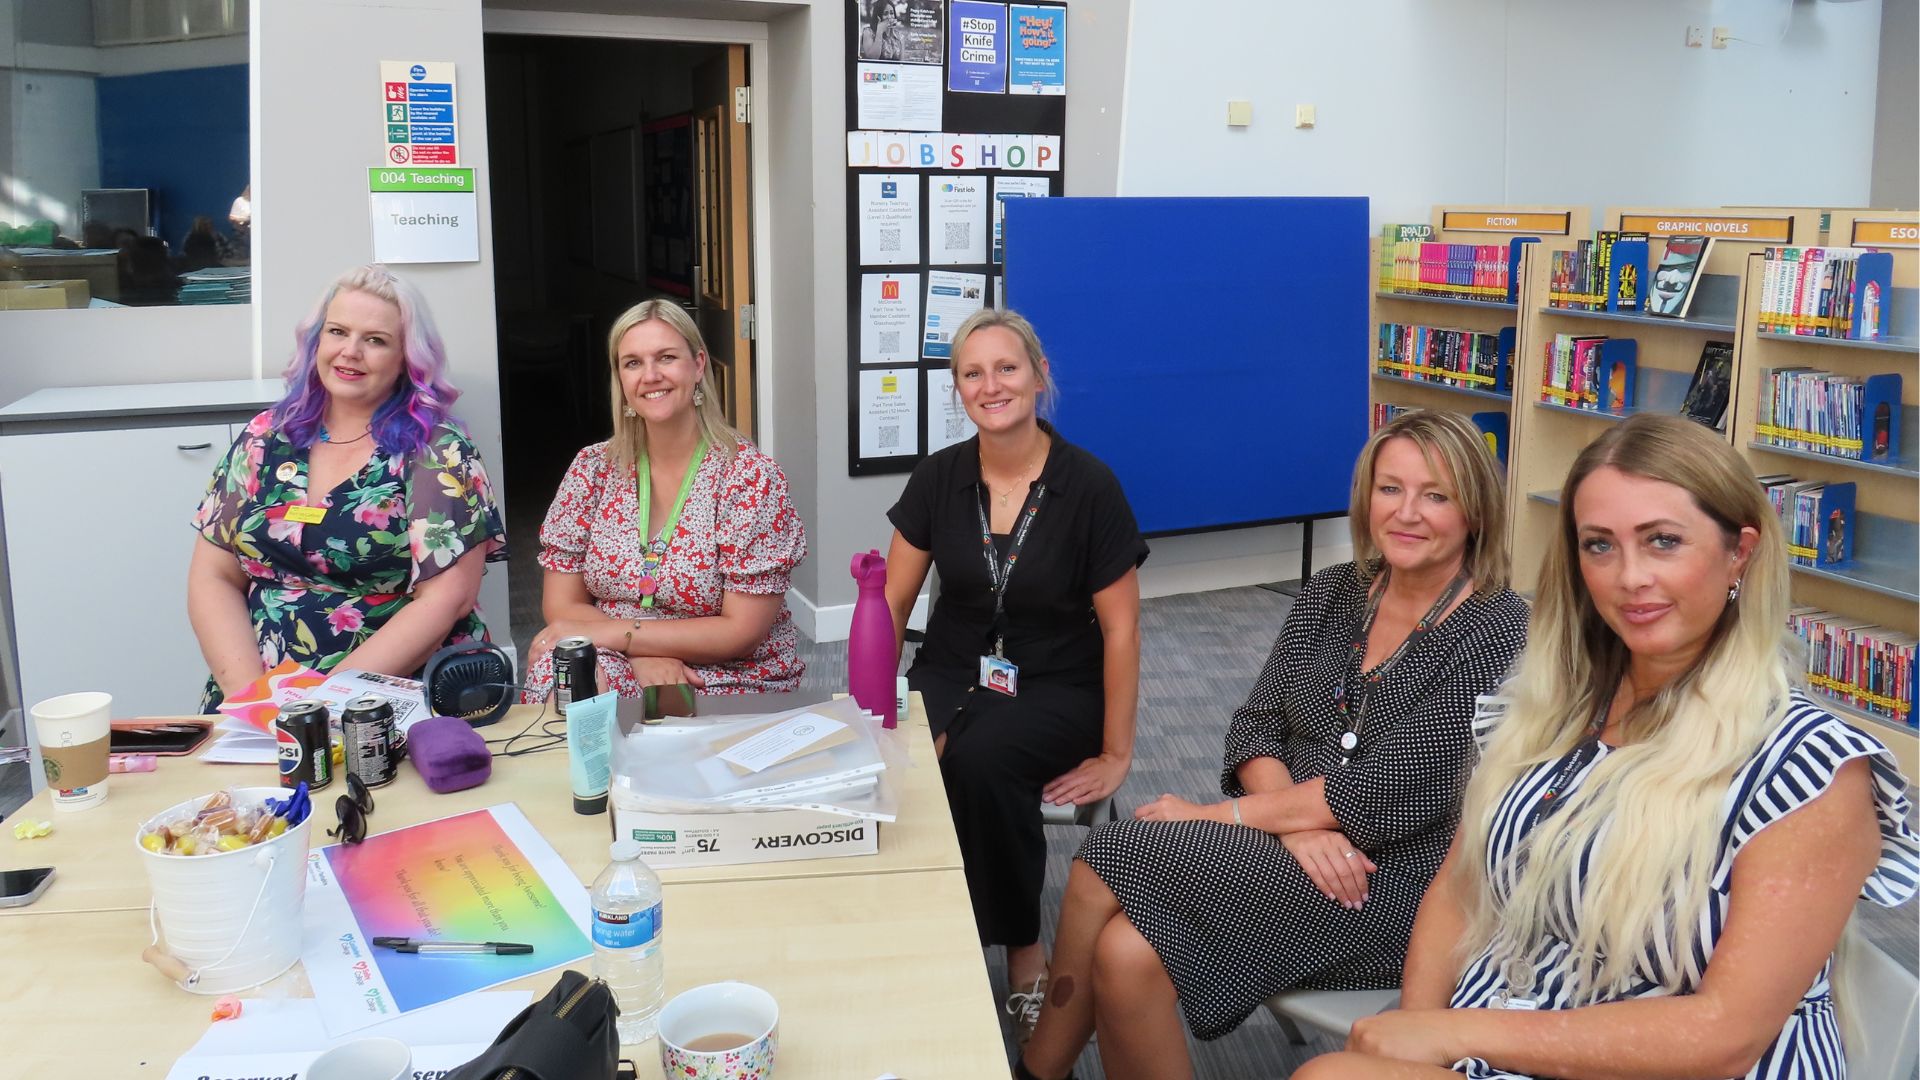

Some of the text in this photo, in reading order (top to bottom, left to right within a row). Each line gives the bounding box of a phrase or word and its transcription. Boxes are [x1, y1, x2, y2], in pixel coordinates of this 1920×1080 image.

[962, 19, 994, 32] #Stop
[964, 34, 992, 46] Knife
[962, 50, 994, 62] Crime
[380, 172, 464, 186] 004 Teaching
[391, 214, 458, 228] Teaching
[1486, 217, 1518, 226] FICTION
[1400, 226, 1430, 237] ROALD
[1656, 222, 1748, 233] GRAPHIC NOVELS
[1890, 228, 1919, 239] ESO
[280, 746, 299, 758] PSI
[1565, 749, 1583, 771] Yorkshire
[754, 827, 864, 850] DISCOVERY
[697, 838, 720, 852] 75
